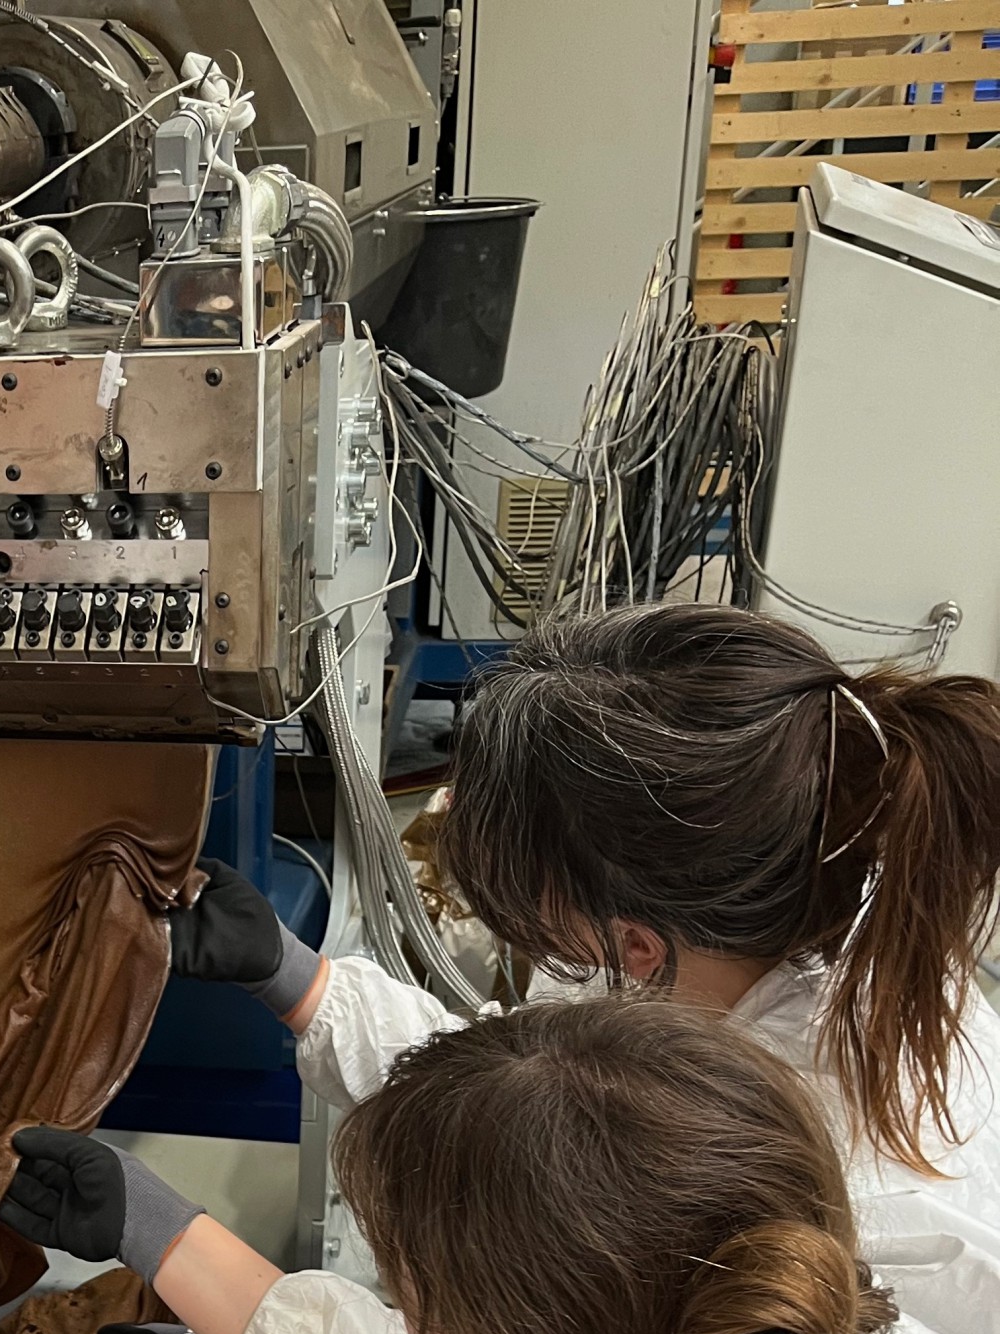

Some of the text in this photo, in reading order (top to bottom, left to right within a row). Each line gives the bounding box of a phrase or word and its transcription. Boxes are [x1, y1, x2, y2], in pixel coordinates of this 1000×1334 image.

[155, 225, 166, 248] 4
[136, 472, 148, 491] 1
[116, 545, 126, 560] 2
[170, 545, 178, 560] 1
